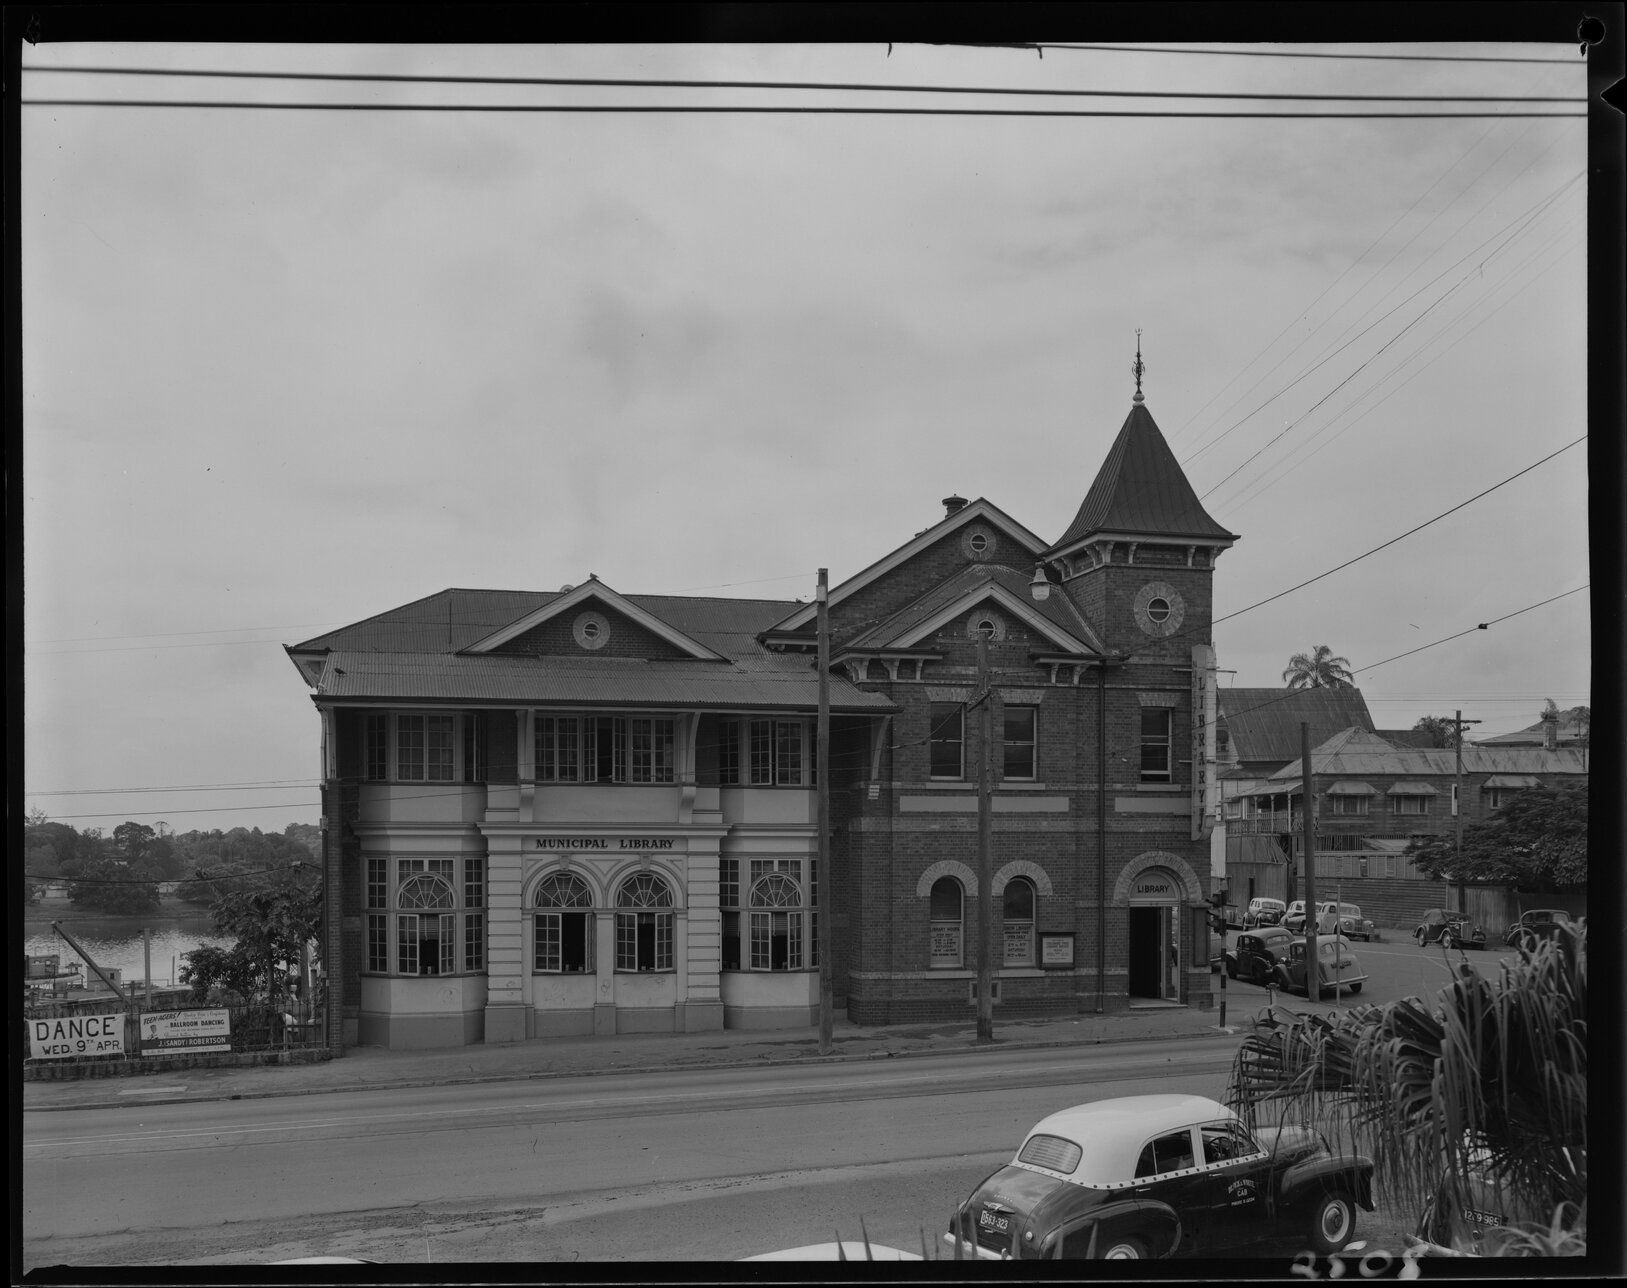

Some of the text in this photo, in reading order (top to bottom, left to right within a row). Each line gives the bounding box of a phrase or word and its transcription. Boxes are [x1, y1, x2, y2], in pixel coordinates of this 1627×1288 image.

[535, 838, 675, 849] MUNICIPAL LIBRARY
[1137, 884, 1170, 893] LIBRARY
[35, 1016, 115, 1041] DANCE
[170, 1020, 198, 1028] BALLROOM
[189, 1037, 226, 1046] ROBERTSON
[42, 1044, 73, 1055] WED.
[96, 1040, 123, 1051] APR.
[1237, 1188, 1248, 1197] CAB
